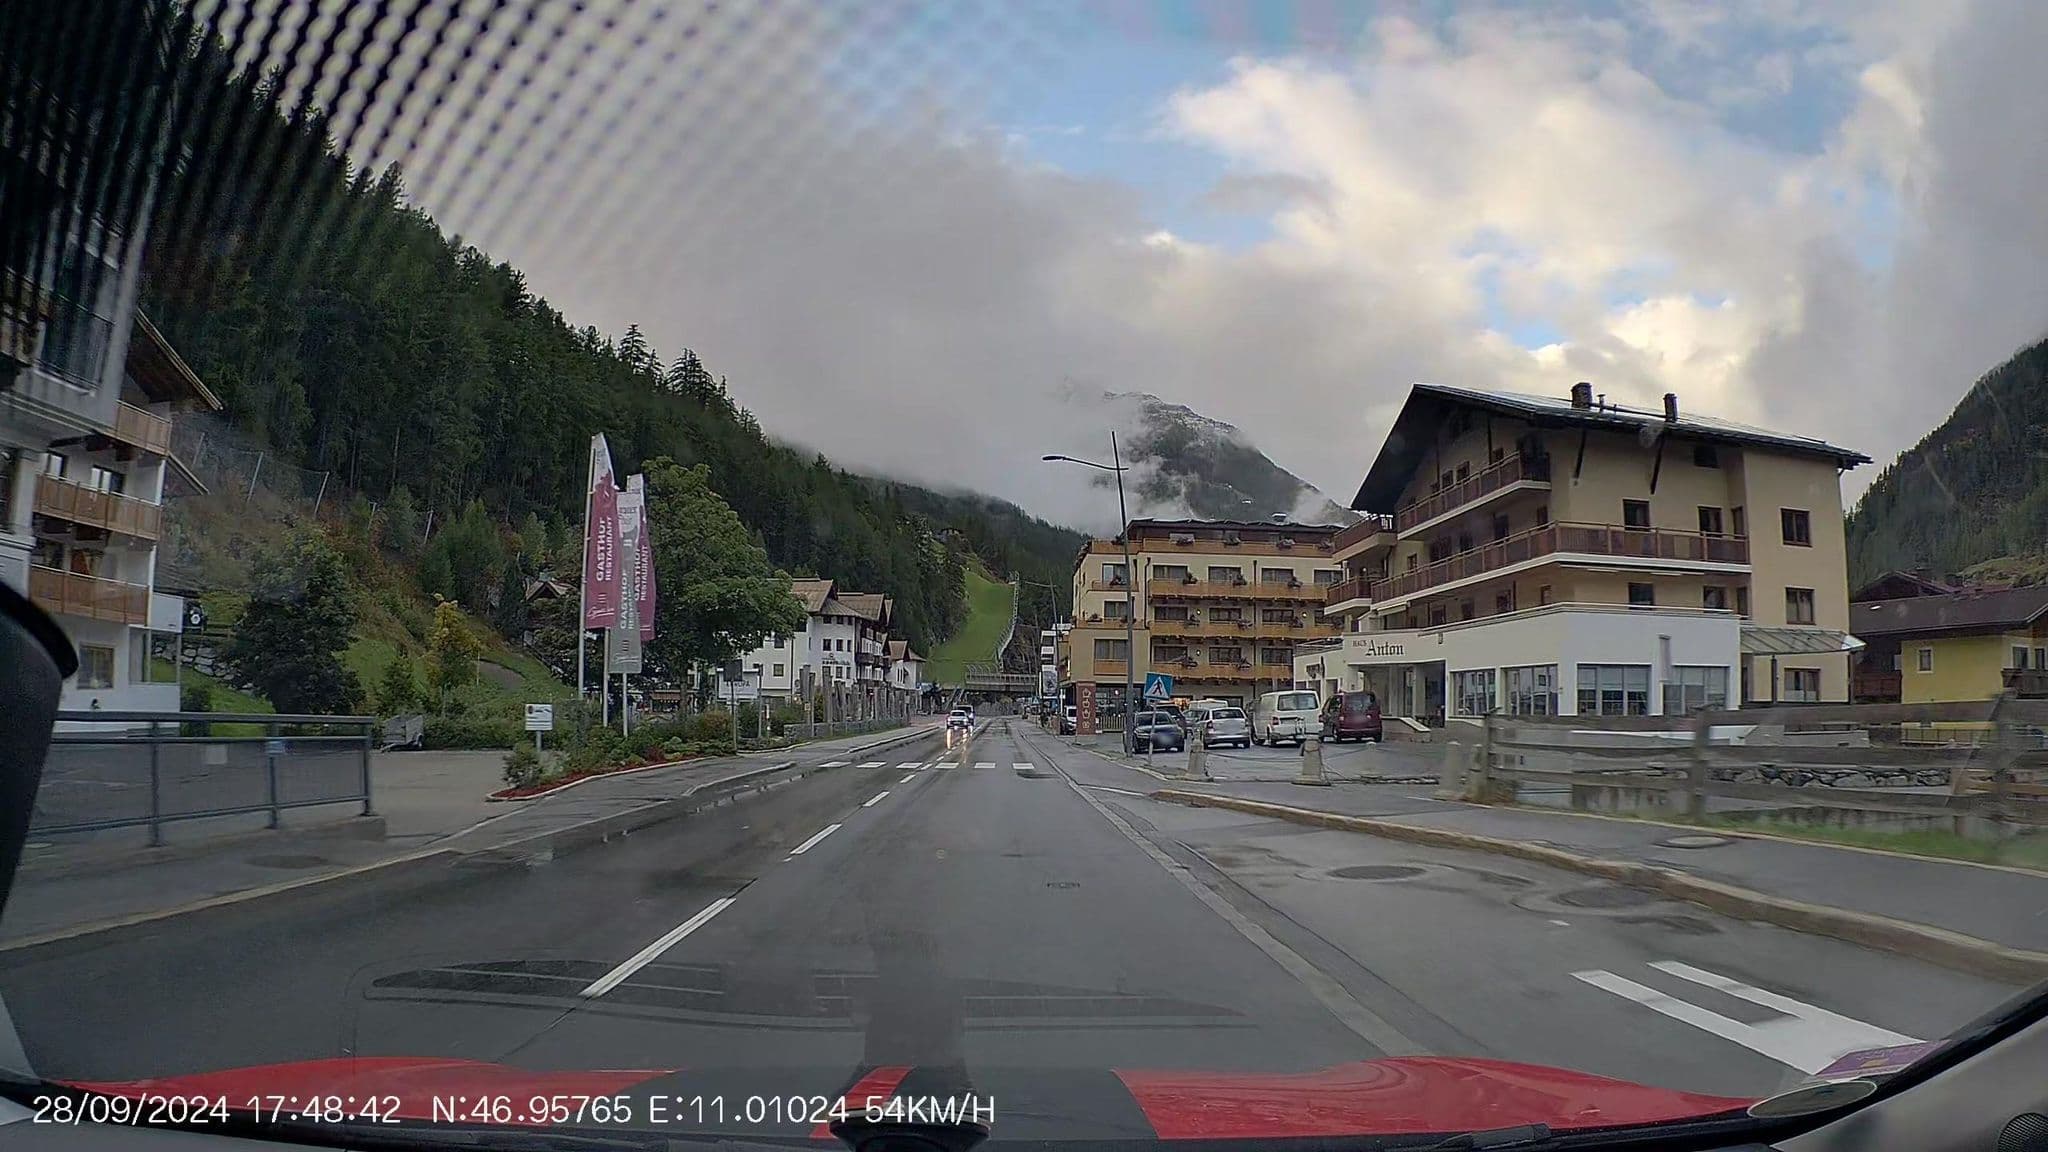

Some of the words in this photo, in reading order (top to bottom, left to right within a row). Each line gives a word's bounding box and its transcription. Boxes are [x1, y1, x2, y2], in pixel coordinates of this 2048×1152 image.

[595, 516, 606, 582] GASTHOF
[605, 515, 613, 582] RESTAURANT
[640, 544, 648, 601] RESTAURANT
[1365, 639, 1404, 656] Anton
